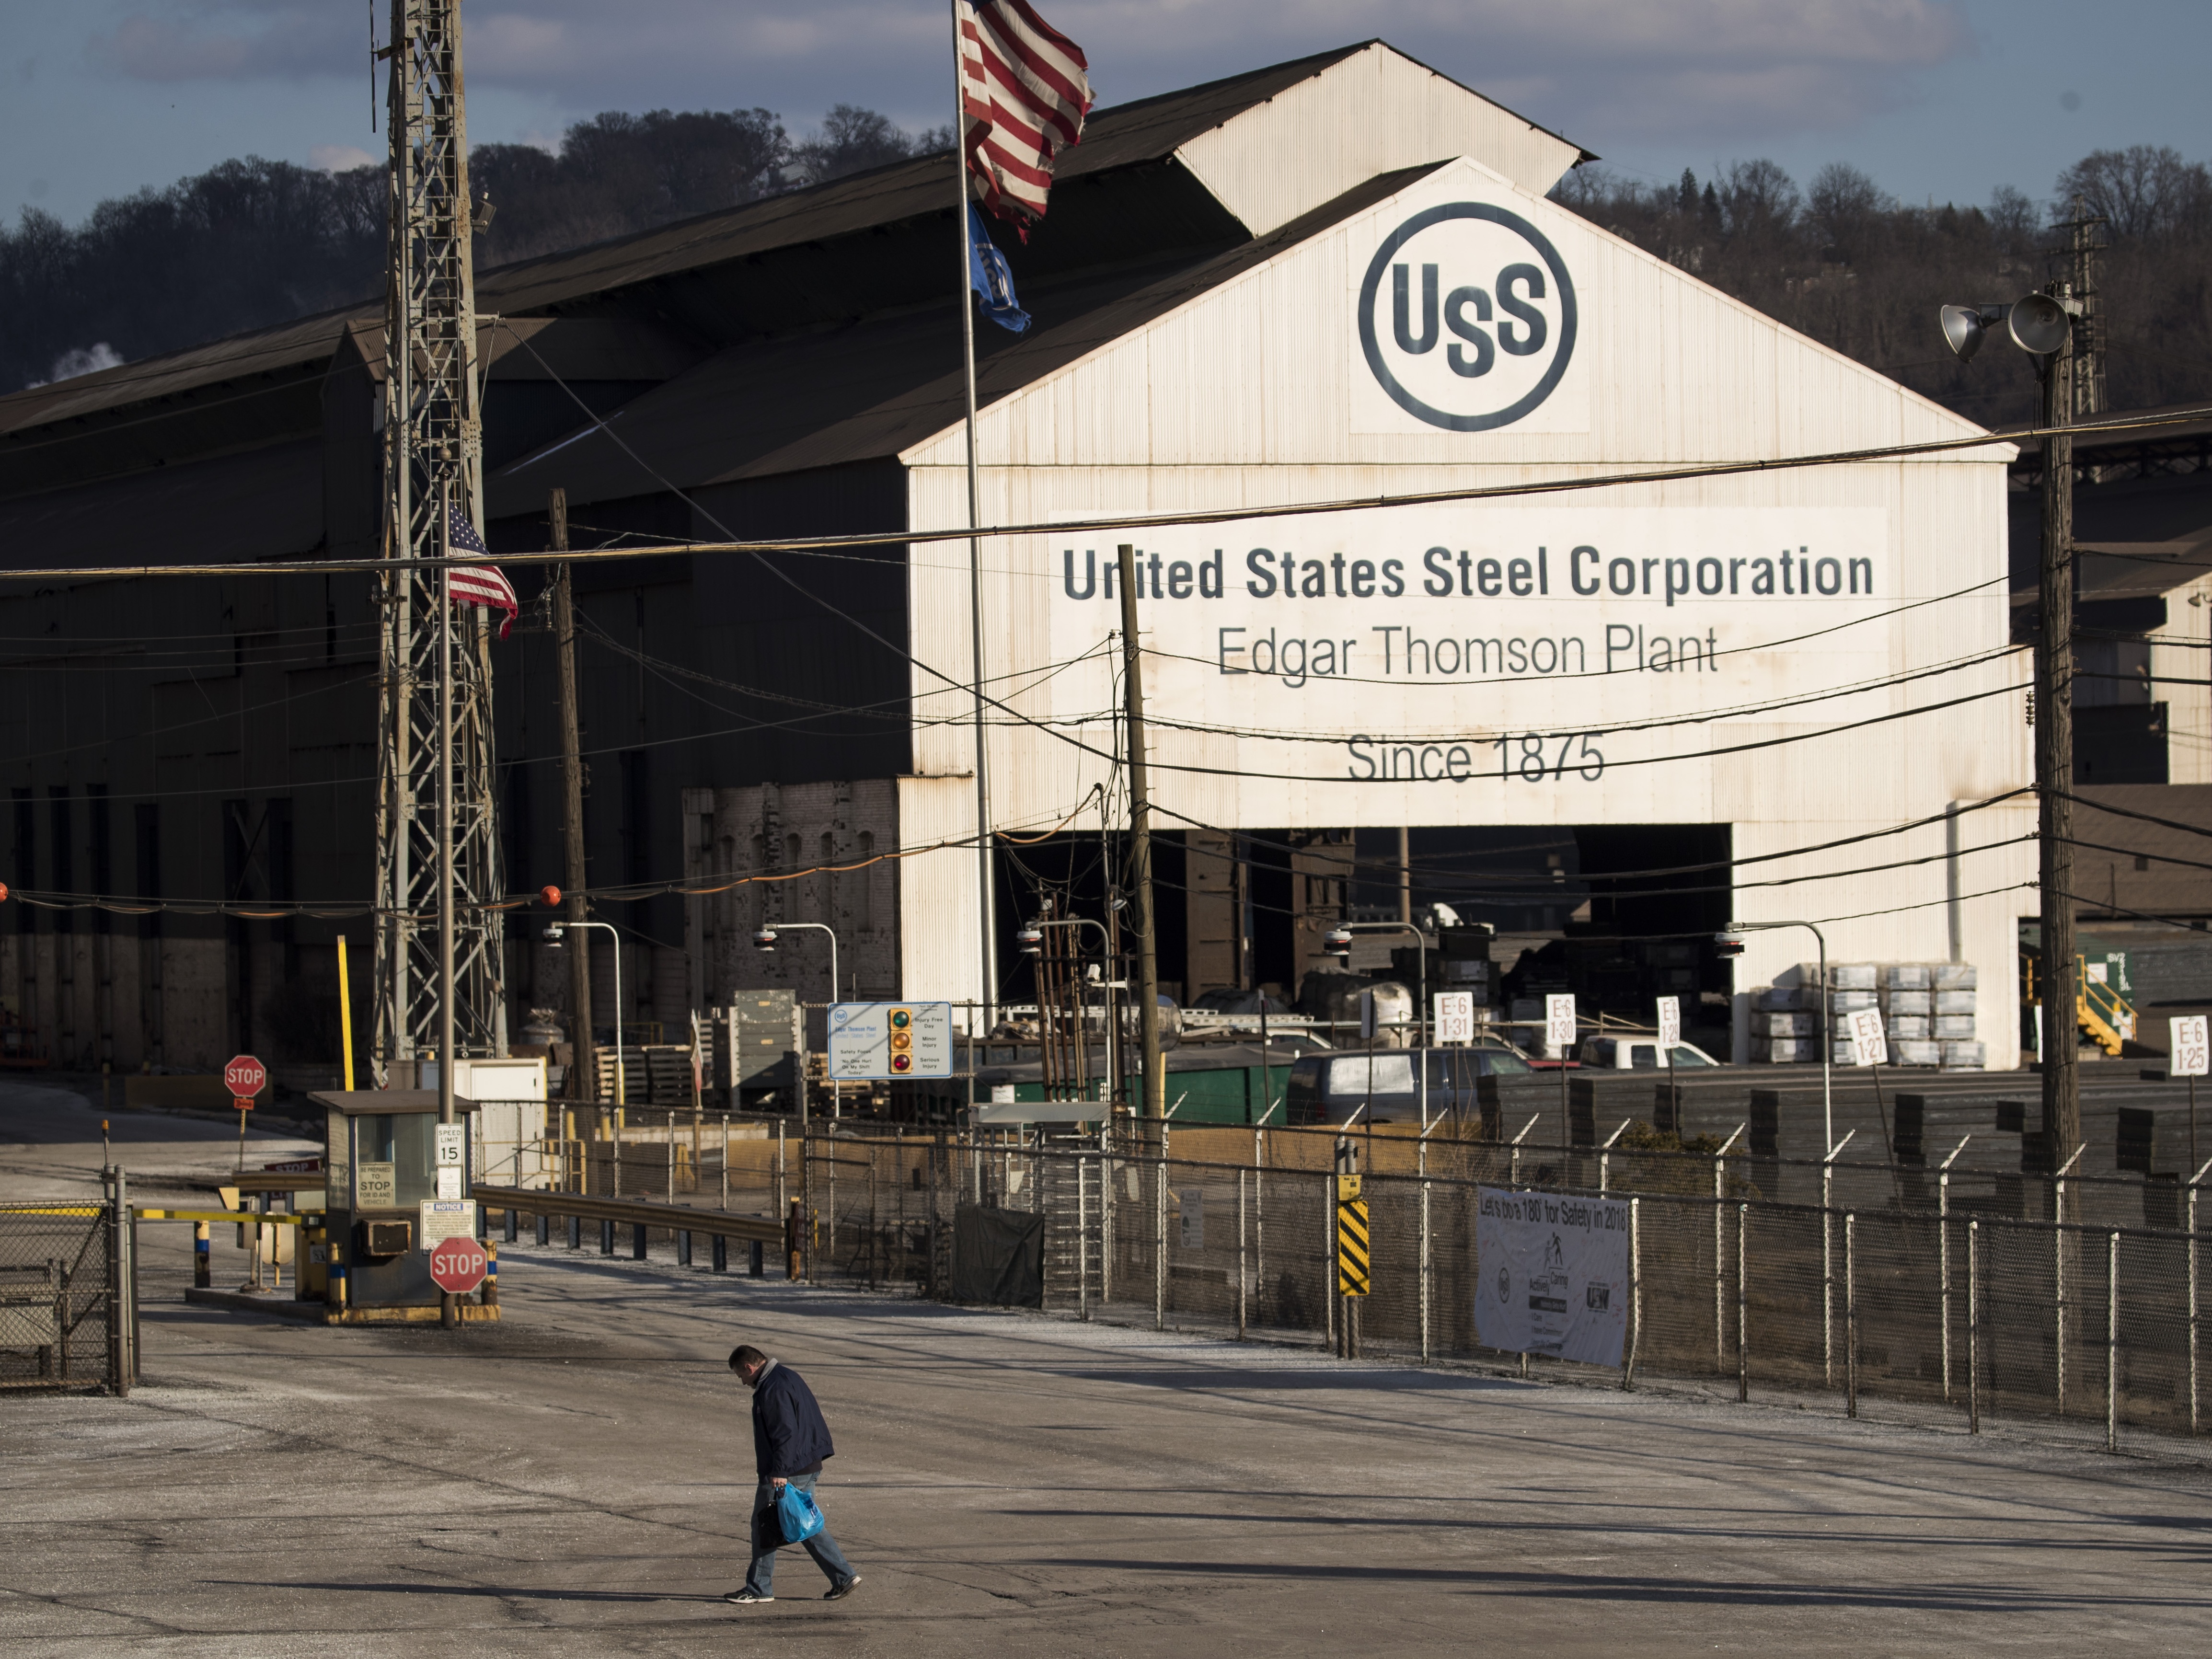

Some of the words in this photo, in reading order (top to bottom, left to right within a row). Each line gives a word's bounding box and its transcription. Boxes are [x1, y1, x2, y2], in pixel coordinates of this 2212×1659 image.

[1393, 263, 1547, 378] USS
[1064, 549, 1223, 600] United
[1246, 547, 1406, 599] States
[1423, 546, 1549, 597] Steel
[1570, 544, 1873, 607] Corporation
[1219, 627, 1357, 689] Edgar
[1372, 625, 1585, 675] Thomson
[1606, 623, 1718, 673] Plant
[1348, 734, 1472, 783] Since
[1493, 732, 1604, 783] 1875
[228, 1068, 263, 1084] STOP
[441, 1147, 458, 1160] 15
[361, 1182, 391, 1191] STOP
[1514, 1203, 1521, 1221] a
[1544, 1199, 1559, 1224] for
[1561, 1200, 1592, 1233] Safety
[1594, 1204, 1603, 1229] in
[1605, 1206, 1626, 1232] 2018
[435, 1254, 483, 1275] STOP
[1530, 1278, 1551, 1296] Actively
[1551, 1271, 1568, 1290] Caring
